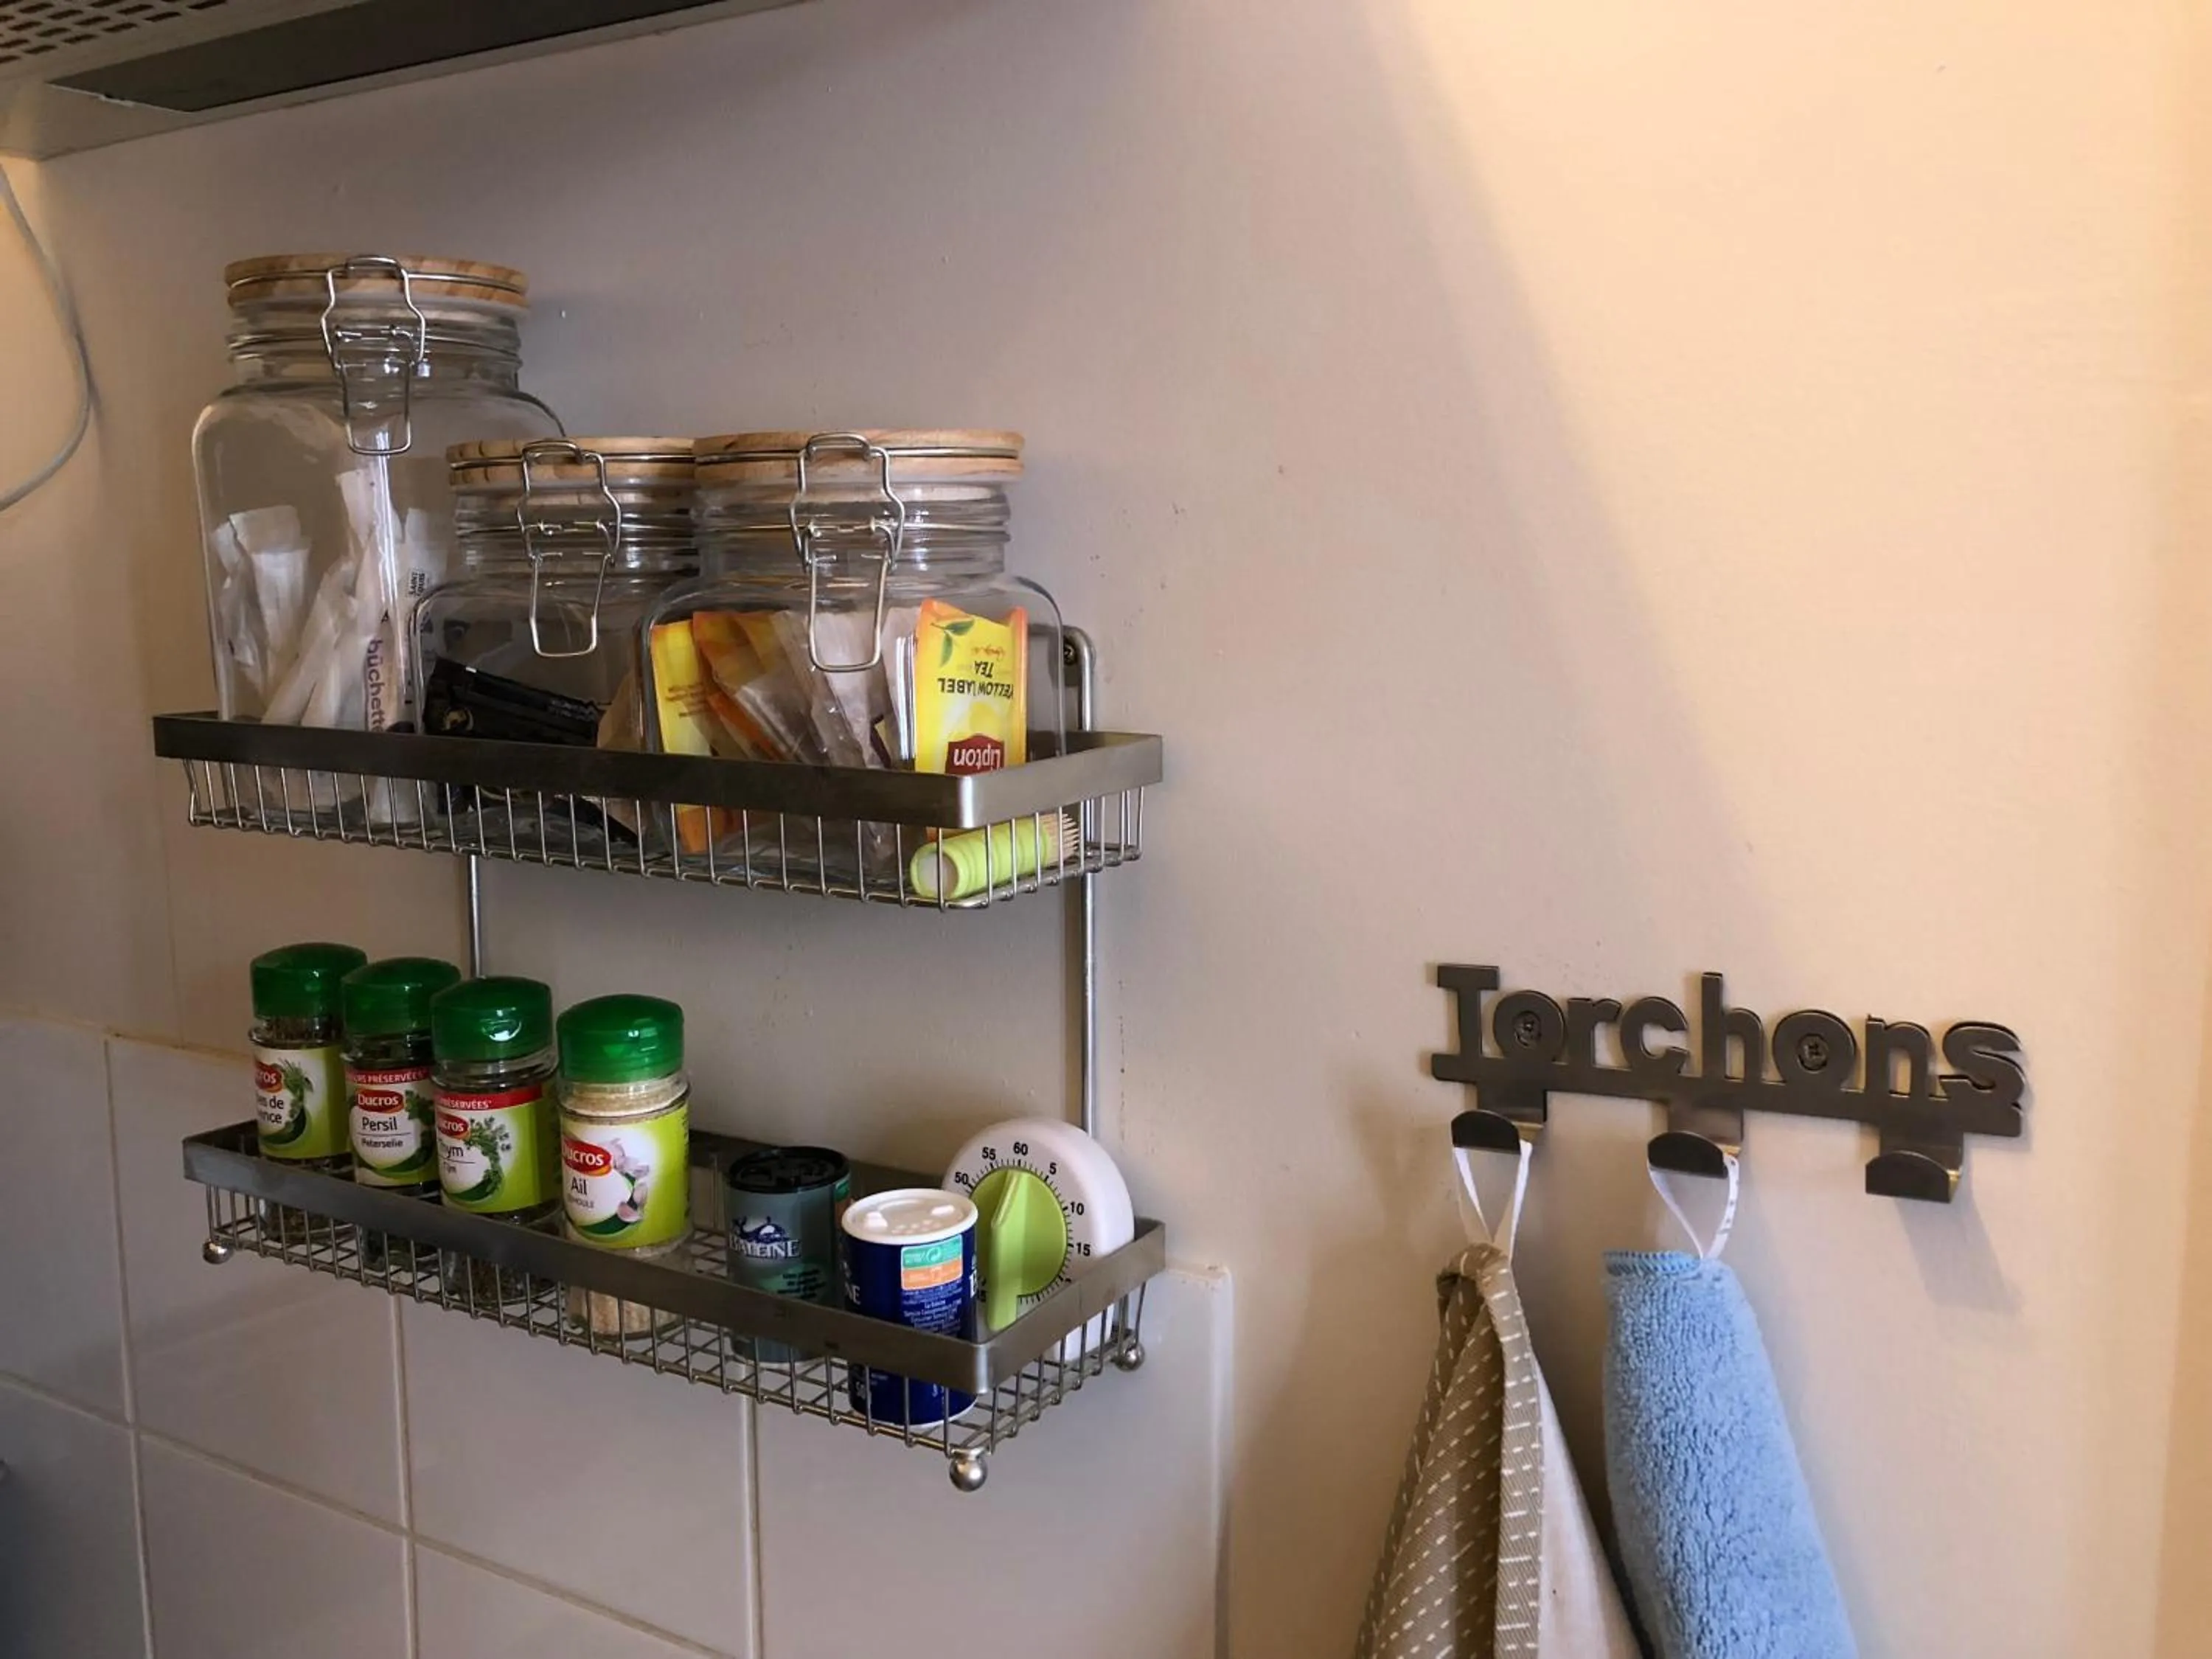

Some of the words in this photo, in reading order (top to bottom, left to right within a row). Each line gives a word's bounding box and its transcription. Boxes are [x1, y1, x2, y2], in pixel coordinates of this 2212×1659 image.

[974, 661, 994, 679] TEA
[937, 678, 975, 697] LABEL
[978, 682, 1014, 700] YELLOW
[953, 742, 1001, 771] Lipton
[1434, 964, 2026, 1117] Torchons
[269, 1095, 285, 1109] de
[358, 1093, 399, 1106] Ducros
[362, 1116, 398, 1131] Persil
[981, 1147, 996, 1161] 55
[1013, 1142, 1028, 1155] 60
[1049, 1163, 1057, 1175] 5
[955, 1172, 969, 1185] 50
[571, 1177, 588, 1195] Ail
[1070, 1202, 1085, 1215] 10
[1076, 1243, 1091, 1256] 15
